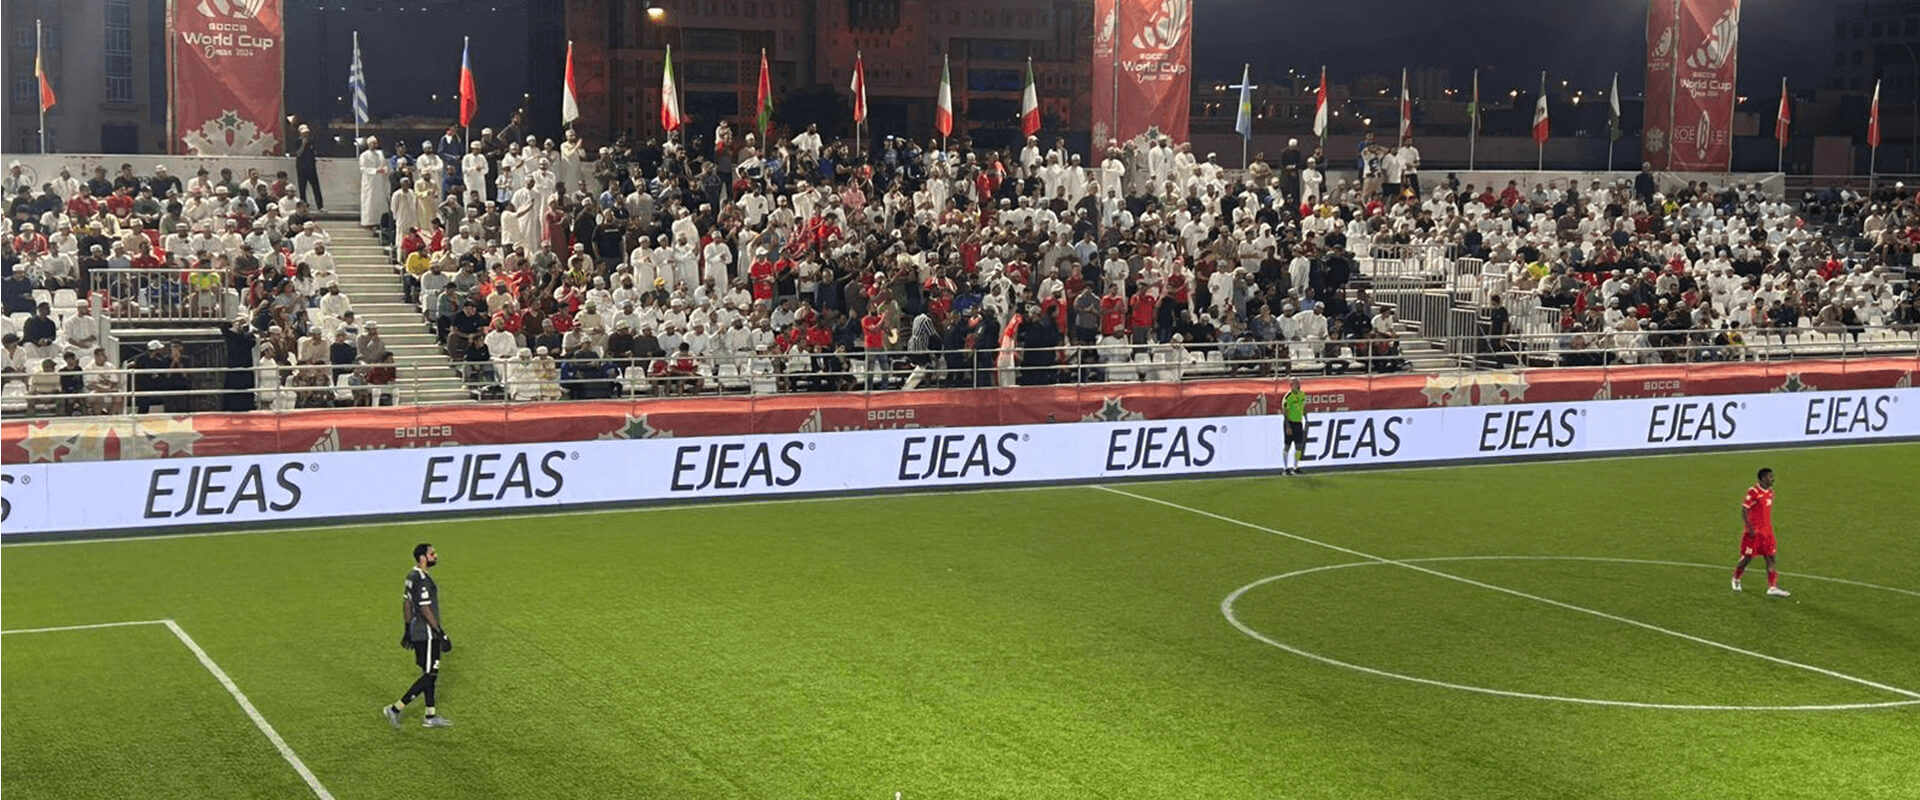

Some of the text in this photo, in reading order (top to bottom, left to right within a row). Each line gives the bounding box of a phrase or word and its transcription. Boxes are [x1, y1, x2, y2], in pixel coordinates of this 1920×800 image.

[182, 31, 274, 50] World Cup
[1122, 60, 1187, 75] World Cup
[1680, 78, 1733, 92] World Cup
